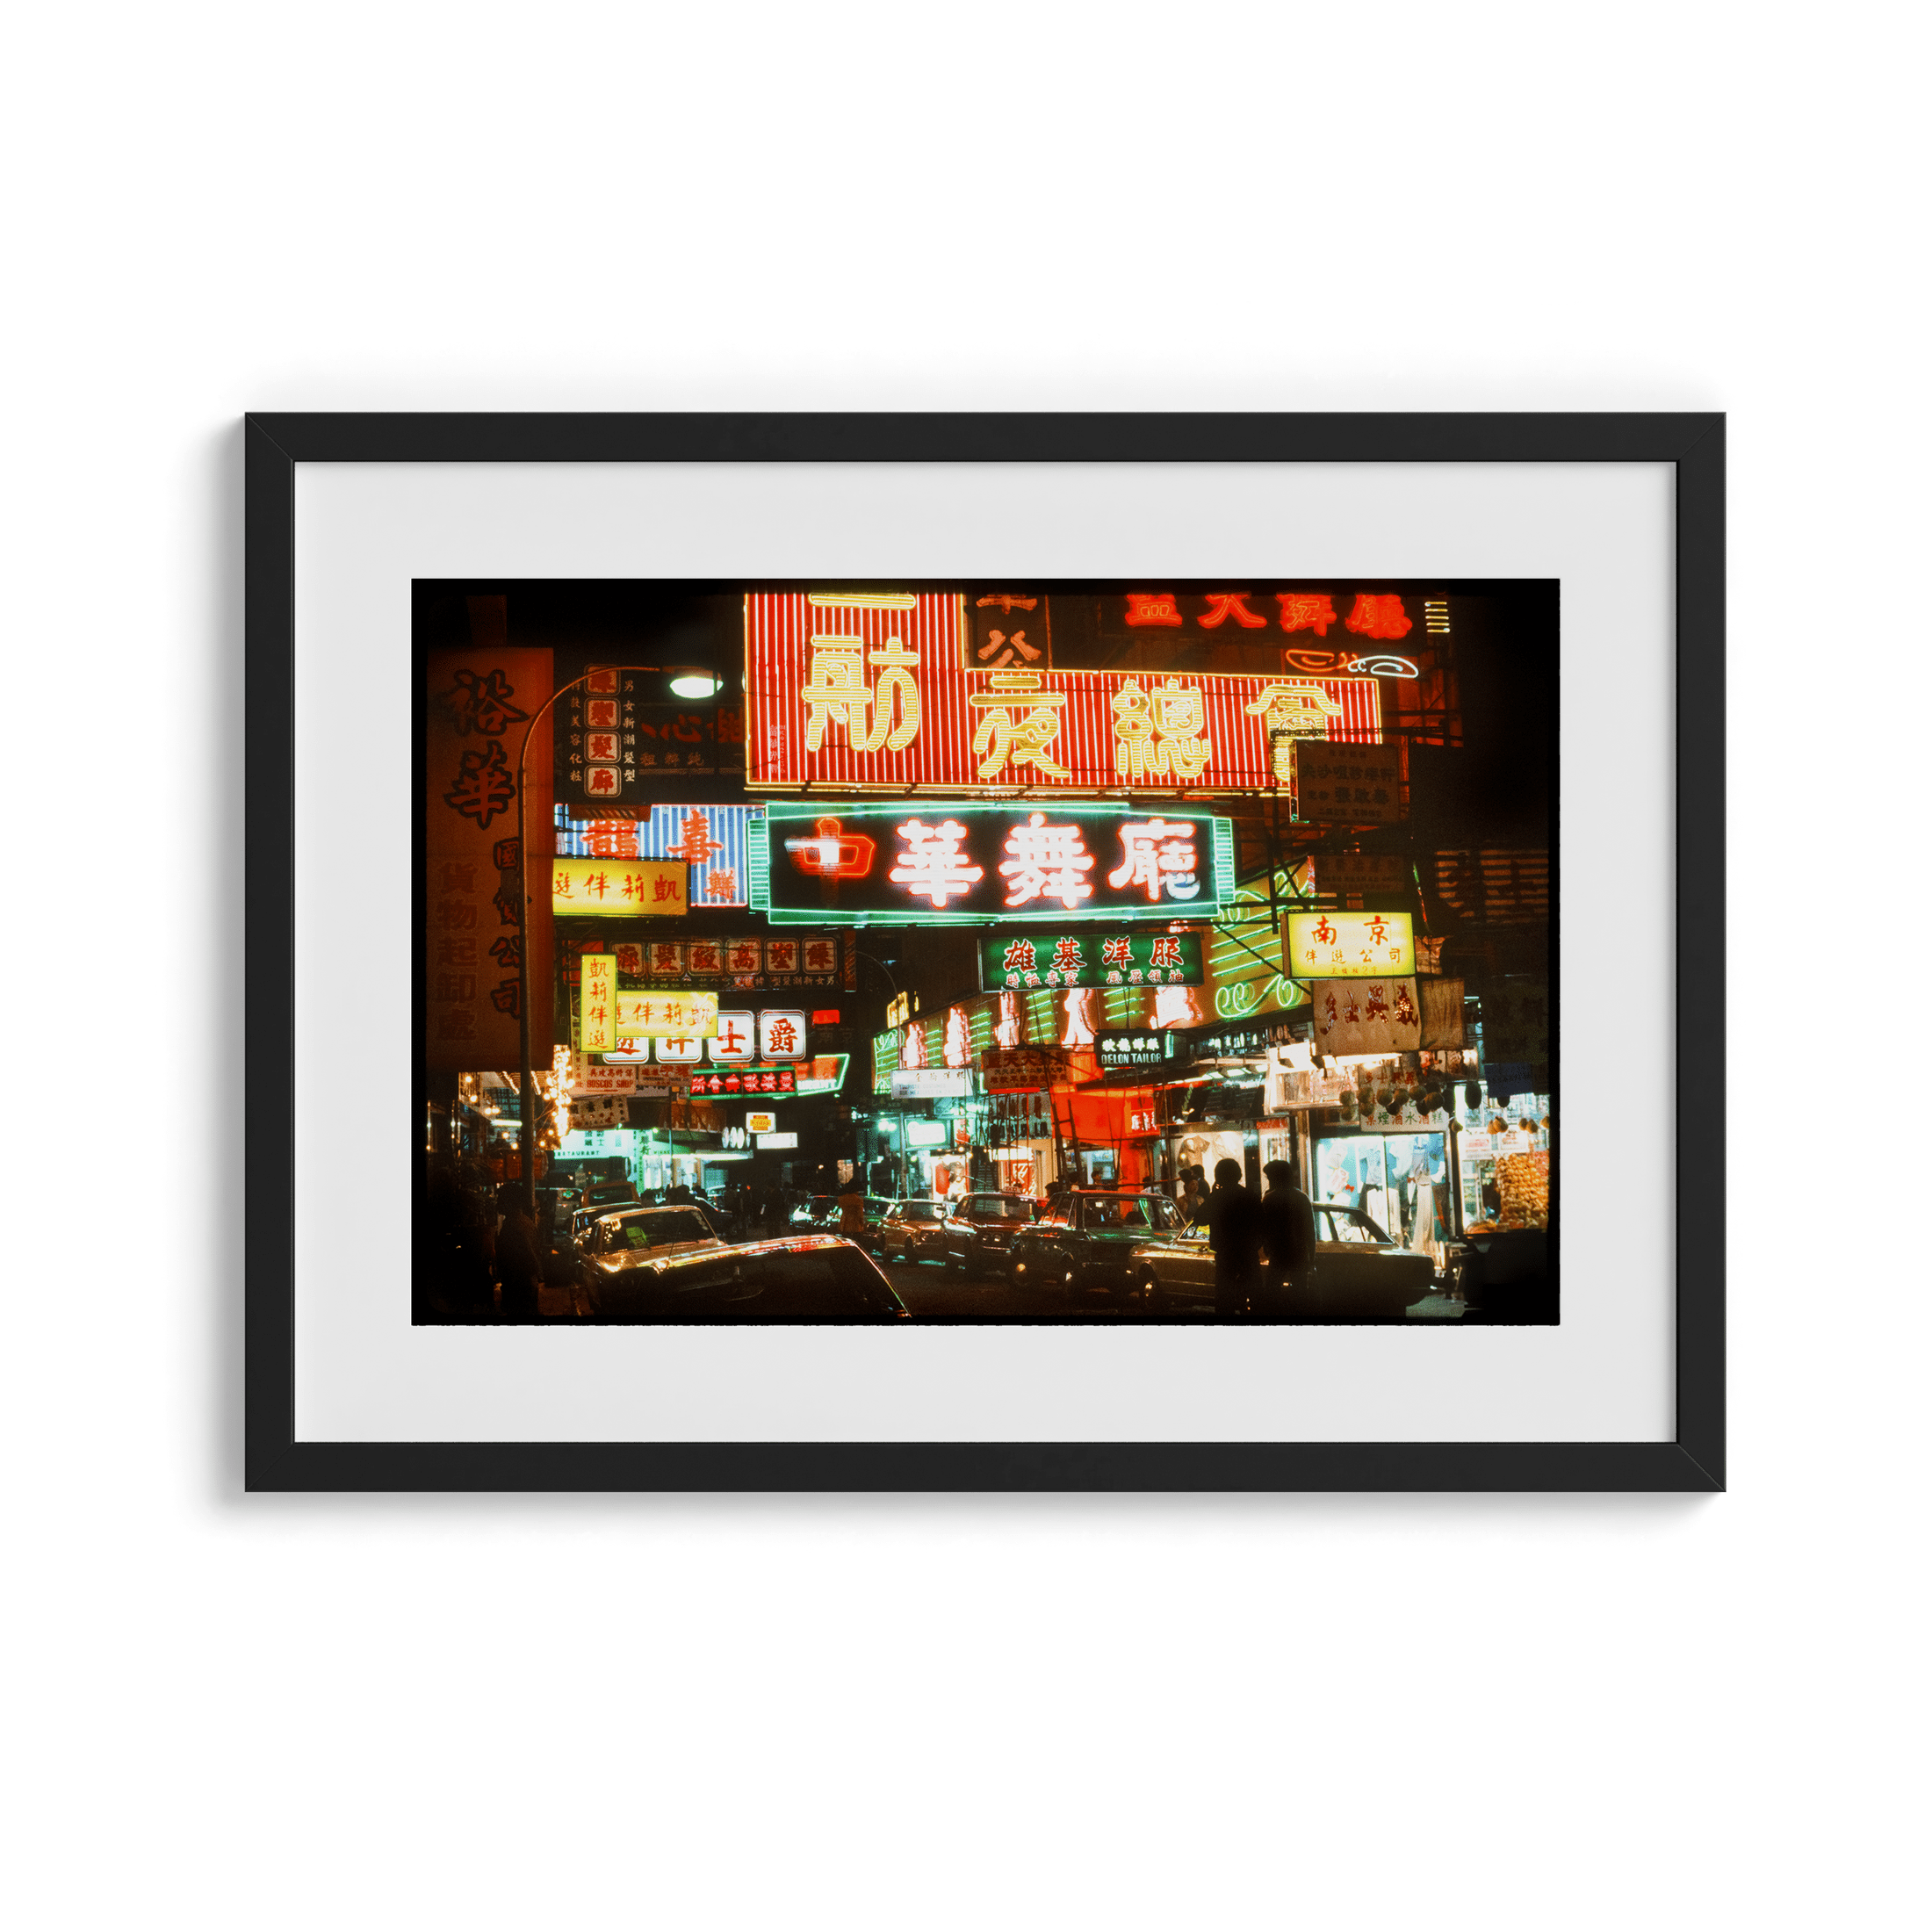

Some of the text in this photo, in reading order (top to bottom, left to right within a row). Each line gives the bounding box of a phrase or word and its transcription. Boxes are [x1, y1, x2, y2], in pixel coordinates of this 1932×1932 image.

[801, 594, 920, 752] 舫
[784, 811, 1200, 910] 中華舞廳
[1311, 915, 1390, 946] 南京
[1003, 936, 1185, 972] 雄基洋服
[1101, 1053, 1162, 1064] DELON TAILOR
[616, 1079, 634, 1088] SHOP
